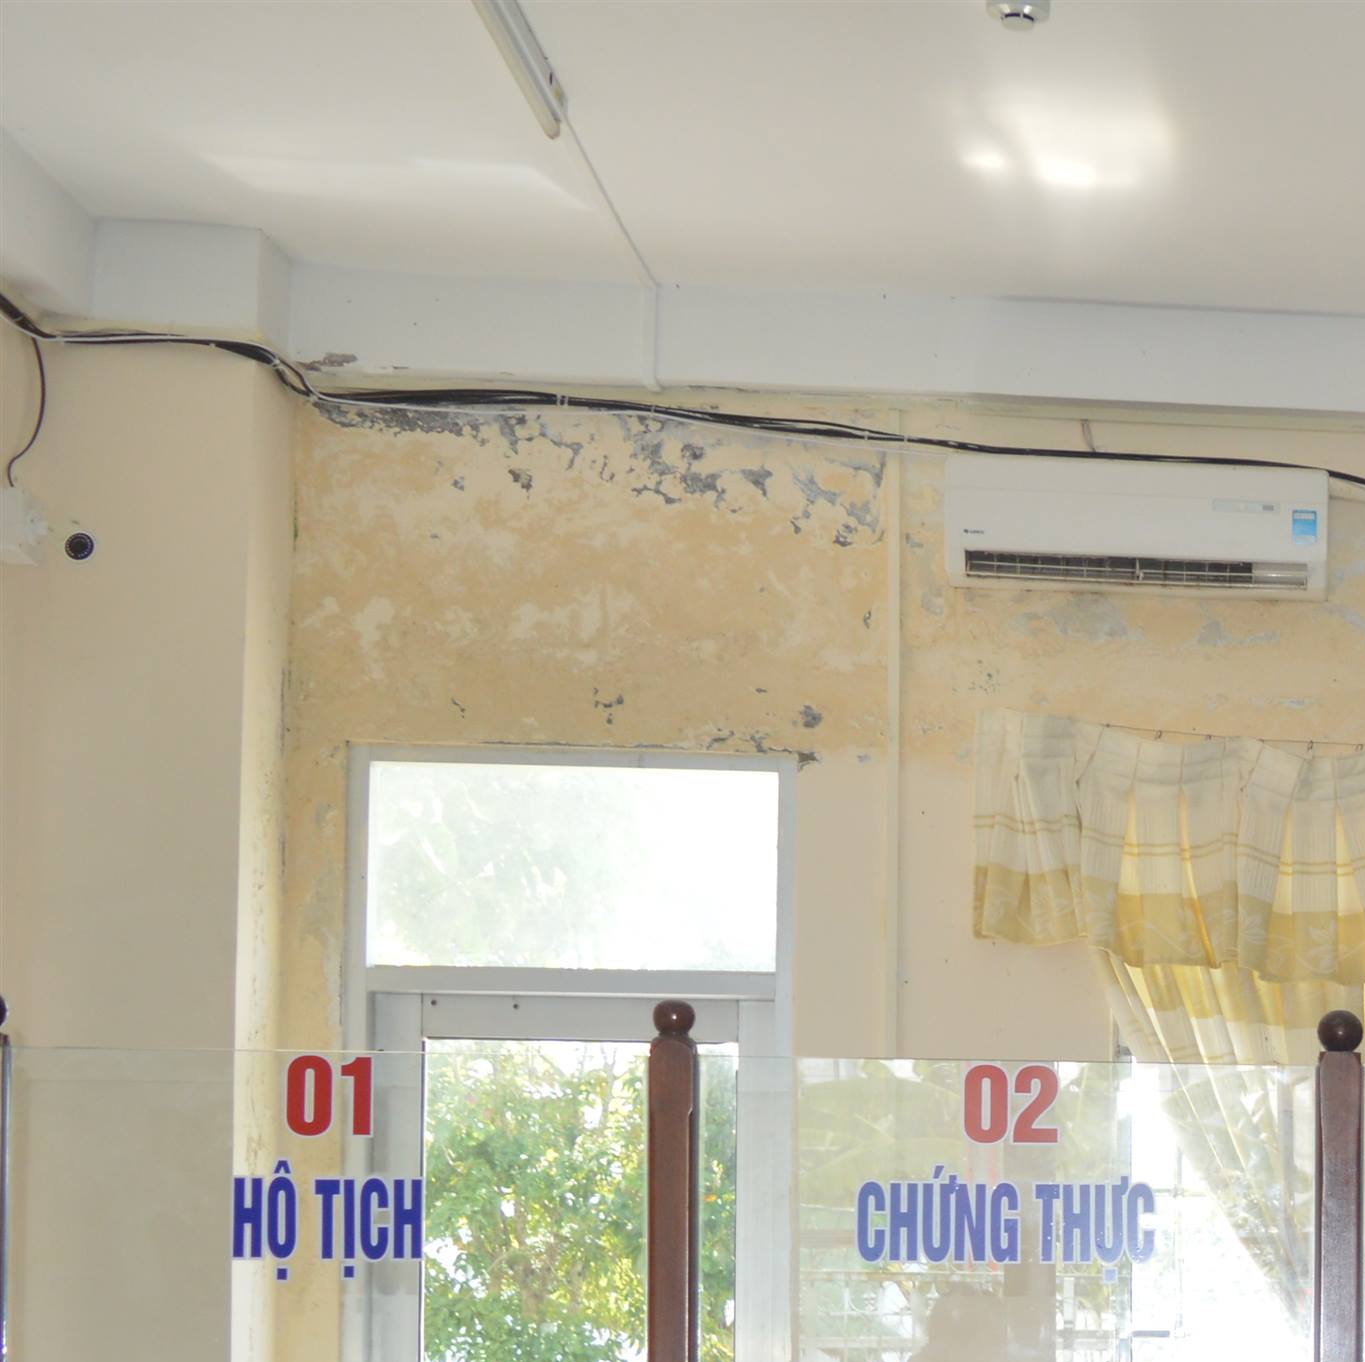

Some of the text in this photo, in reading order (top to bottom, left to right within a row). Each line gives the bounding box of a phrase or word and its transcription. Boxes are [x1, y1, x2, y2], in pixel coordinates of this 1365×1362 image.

[286, 1054, 373, 1137] 01
[963, 1064, 1060, 1144] 02
[232, 1159, 423, 1281] HỘ TỊCH
[856, 1164, 1156, 1284] CHỨNG THỰC
